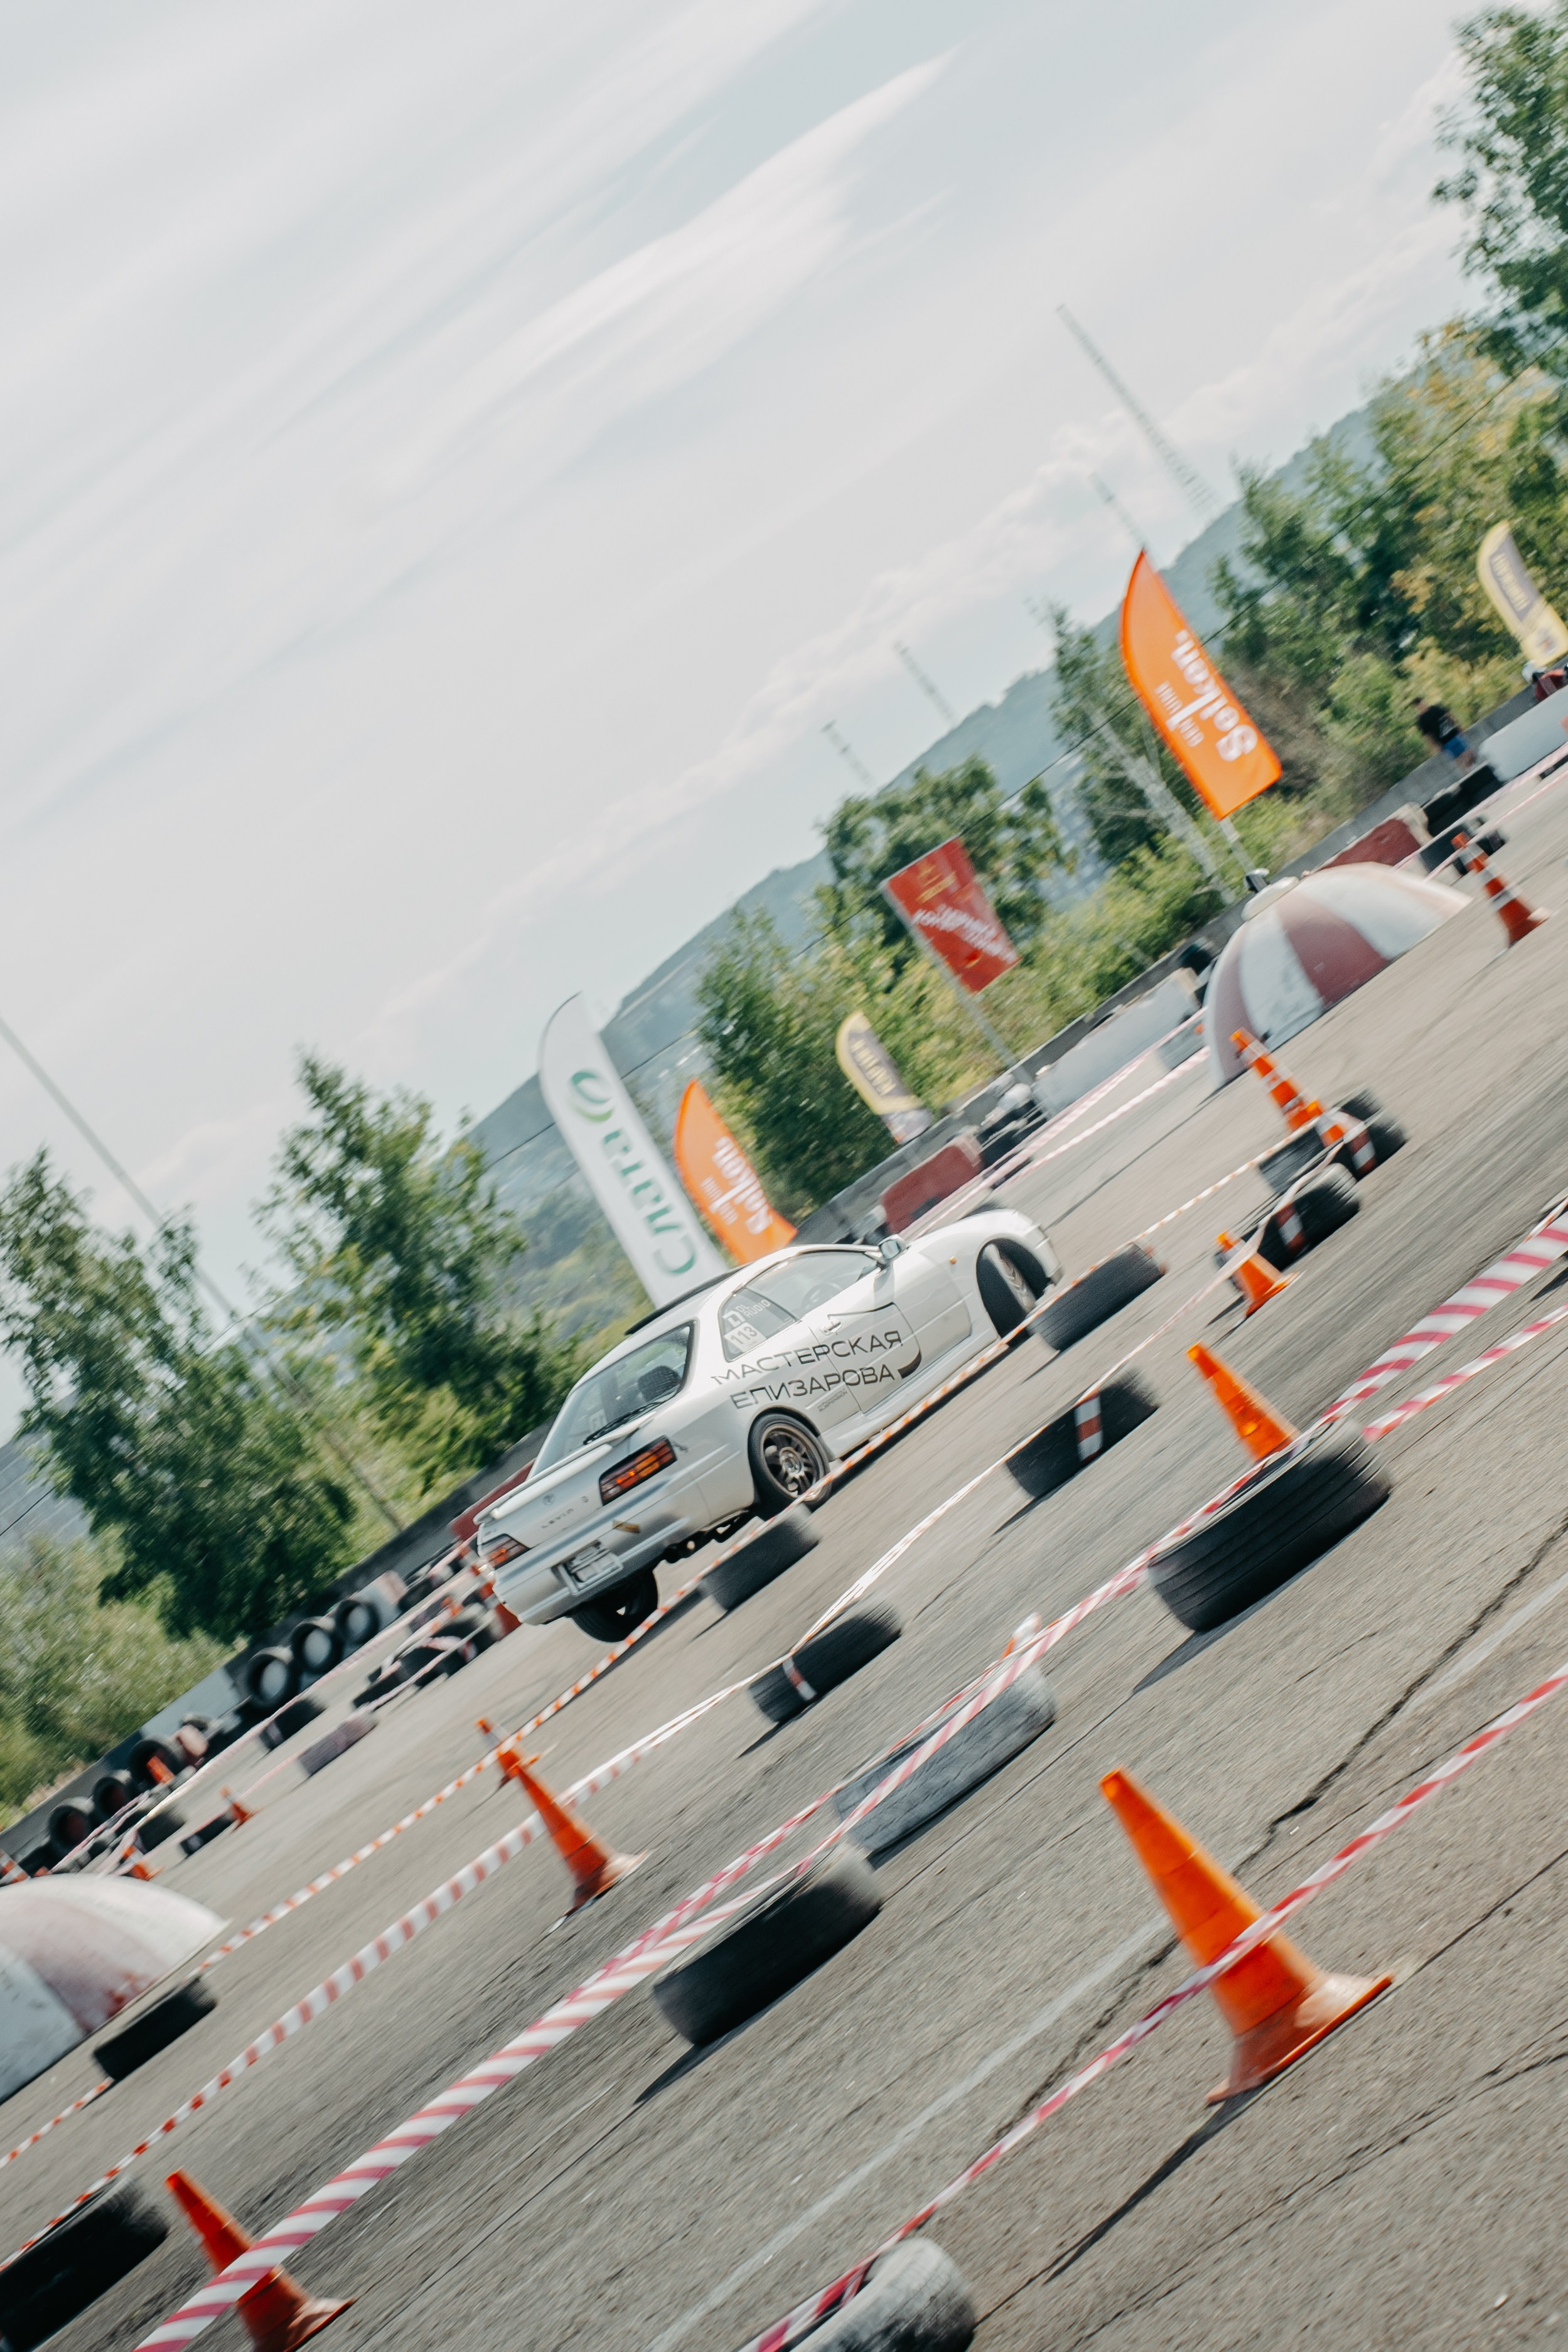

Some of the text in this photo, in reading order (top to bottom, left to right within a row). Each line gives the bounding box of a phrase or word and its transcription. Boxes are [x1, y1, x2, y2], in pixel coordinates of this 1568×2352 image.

[601, 1129, 697, 1276] Слата
[735, 1304, 750, 1313] DL
[743, 1299, 771, 1318] AUDIO
[731, 1326, 758, 1345] 113
[711, 1330, 903, 1385] МАСТЕРСКАЯ
